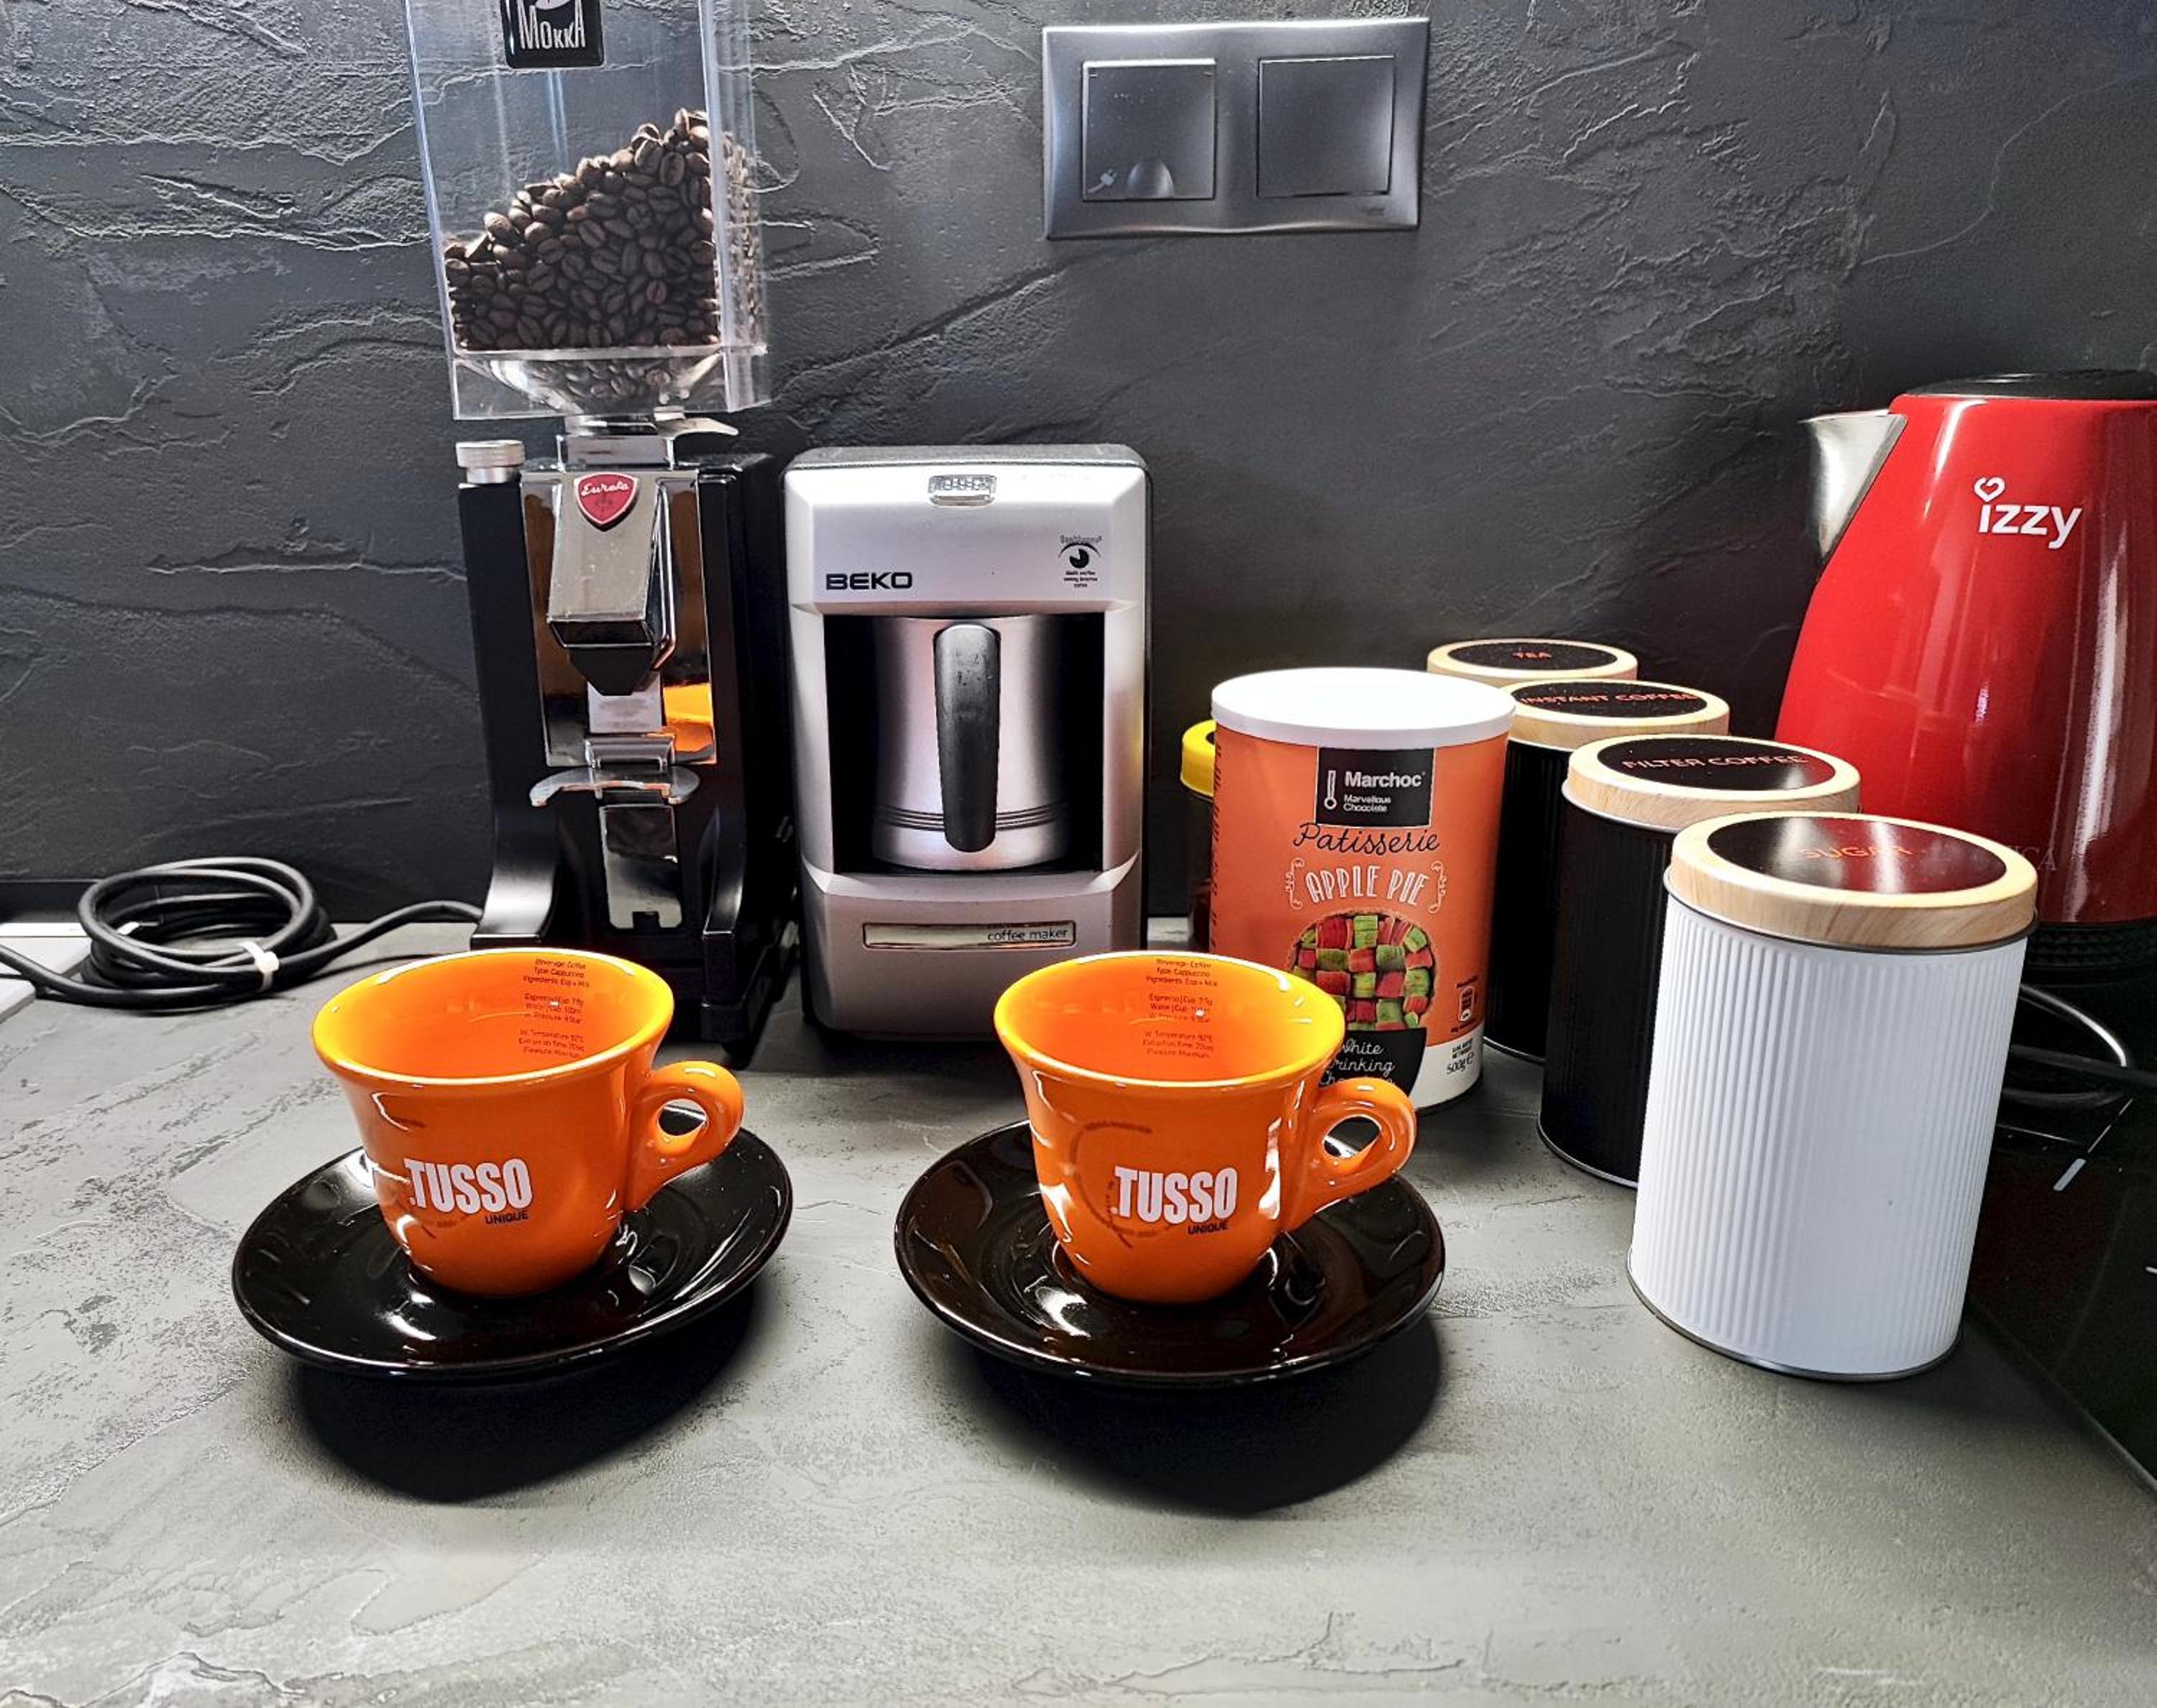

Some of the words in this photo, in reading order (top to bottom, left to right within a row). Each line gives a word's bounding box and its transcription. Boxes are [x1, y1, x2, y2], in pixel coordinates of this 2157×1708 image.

[1974, 477, 2083, 549] izzy
[826, 572, 912, 590] BEKO
[1621, 758, 1706, 769] FILTER
[1708, 756, 1809, 766] COFFEE
[1345, 771, 1421, 788] Marchoc
[1293, 822, 1440, 855] Patisserie
[1305, 865, 1381, 904] APPLE
[1387, 868, 1429, 906] PIE
[987, 929, 1025, 941] coffee
[1029, 927, 1068, 940] maker
[403, 1158, 533, 1214] TUSSO
[1114, 1166, 1238, 1224] TUSSO
[484, 1211, 528, 1224] UNIQUE
[1187, 1221, 1229, 1235] UNIQUE
